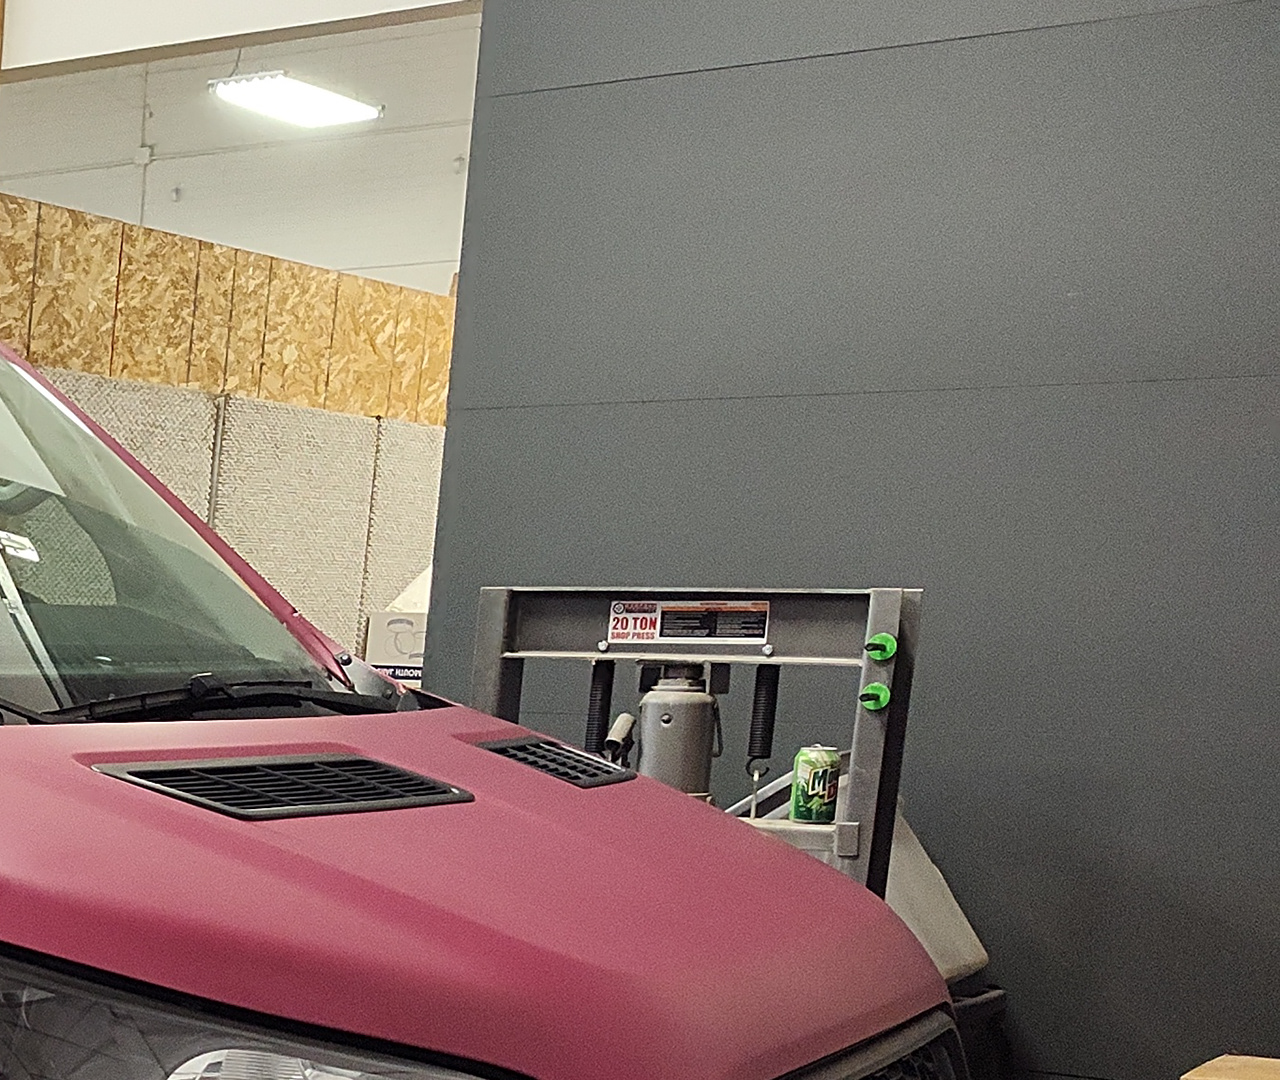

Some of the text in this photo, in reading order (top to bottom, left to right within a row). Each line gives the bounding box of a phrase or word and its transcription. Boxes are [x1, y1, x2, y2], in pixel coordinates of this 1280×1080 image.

[612, 616, 629, 630] 20
[631, 616, 657, 630] TON
[610, 631, 656, 640] SHOP PRESS
